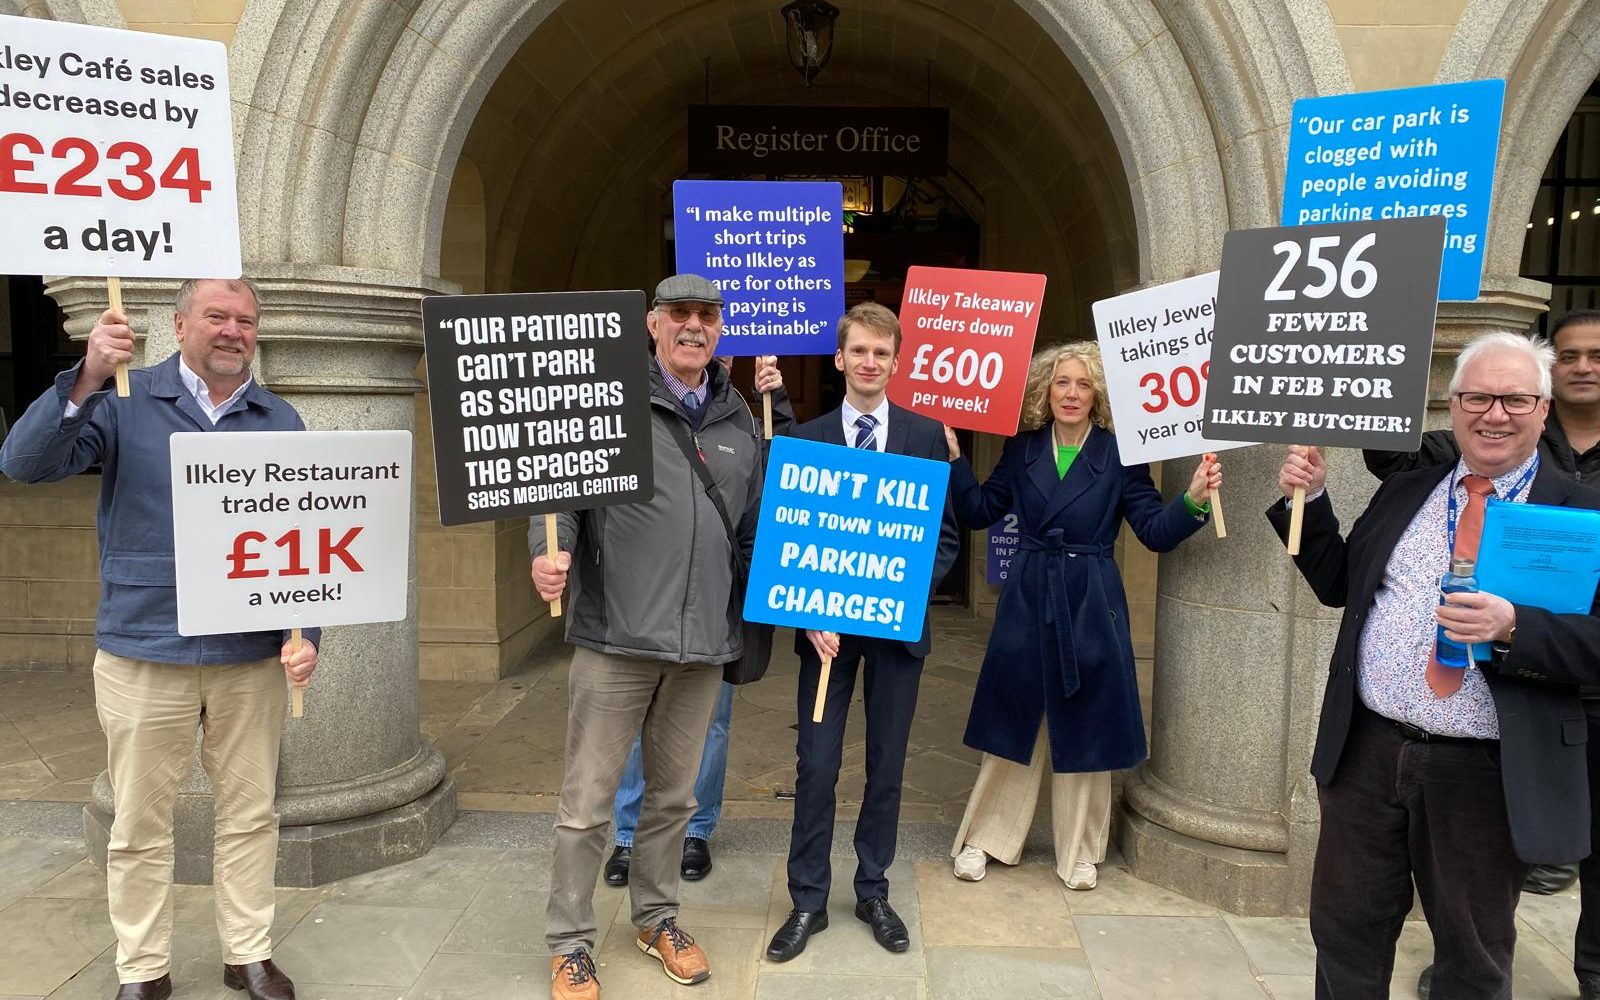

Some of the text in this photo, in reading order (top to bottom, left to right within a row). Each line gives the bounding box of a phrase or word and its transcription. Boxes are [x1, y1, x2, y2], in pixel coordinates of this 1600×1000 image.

[59, 52, 132, 81] Café
[140, 65, 215, 90] sales
[0, 84, 199, 129] decreased by
[1299, 103, 1470, 135] "Our car park is
[715, 125, 921, 158] Register Office
[1305, 138, 1438, 167] clogged with
[0, 133, 212, 203] £234
[1302, 167, 1468, 198] people avoiding
[686, 205, 831, 226] "I make multiple
[1299, 201, 1468, 225] parking charges
[43, 219, 173, 261] a day!
[714, 230, 806, 248] short trips
[706, 252, 816, 271] into Ilkley as
[1264, 232, 1378, 301] 256
[745, 274, 771, 291] for
[775, 275, 832, 291] others
[730, 298, 806, 317] paying is
[908, 288, 1035, 318] Ilkley Takeaway
[917, 314, 1014, 337] orders down
[1108, 316, 1157, 338] Ilkley
[1266, 312, 1368, 332] FEWER
[1120, 336, 1189, 363] takings
[1230, 344, 1405, 365] CUSTOMERS
[909, 343, 1004, 390] £600
[1139, 360, 1211, 413] 30
[1232, 375, 1393, 398] IN FEB FOR
[912, 391, 989, 414] per week!
[1138, 421, 1179, 444] year
[1211, 409, 1411, 433] ILKLEY BUTCHER!
[186, 462, 400, 487] Ilkley Restaurant
[779, 463, 929, 511] DON'T KILL
[221, 491, 366, 513] trade down
[775, 506, 924, 543] OUR TOWN WITH
[226, 526, 364, 580] £1K
[780, 542, 906, 583] PARKING
[996, 548, 1007, 556] IN
[248, 583, 342, 606] a week!
[768, 584, 905, 632] CHARGES!
